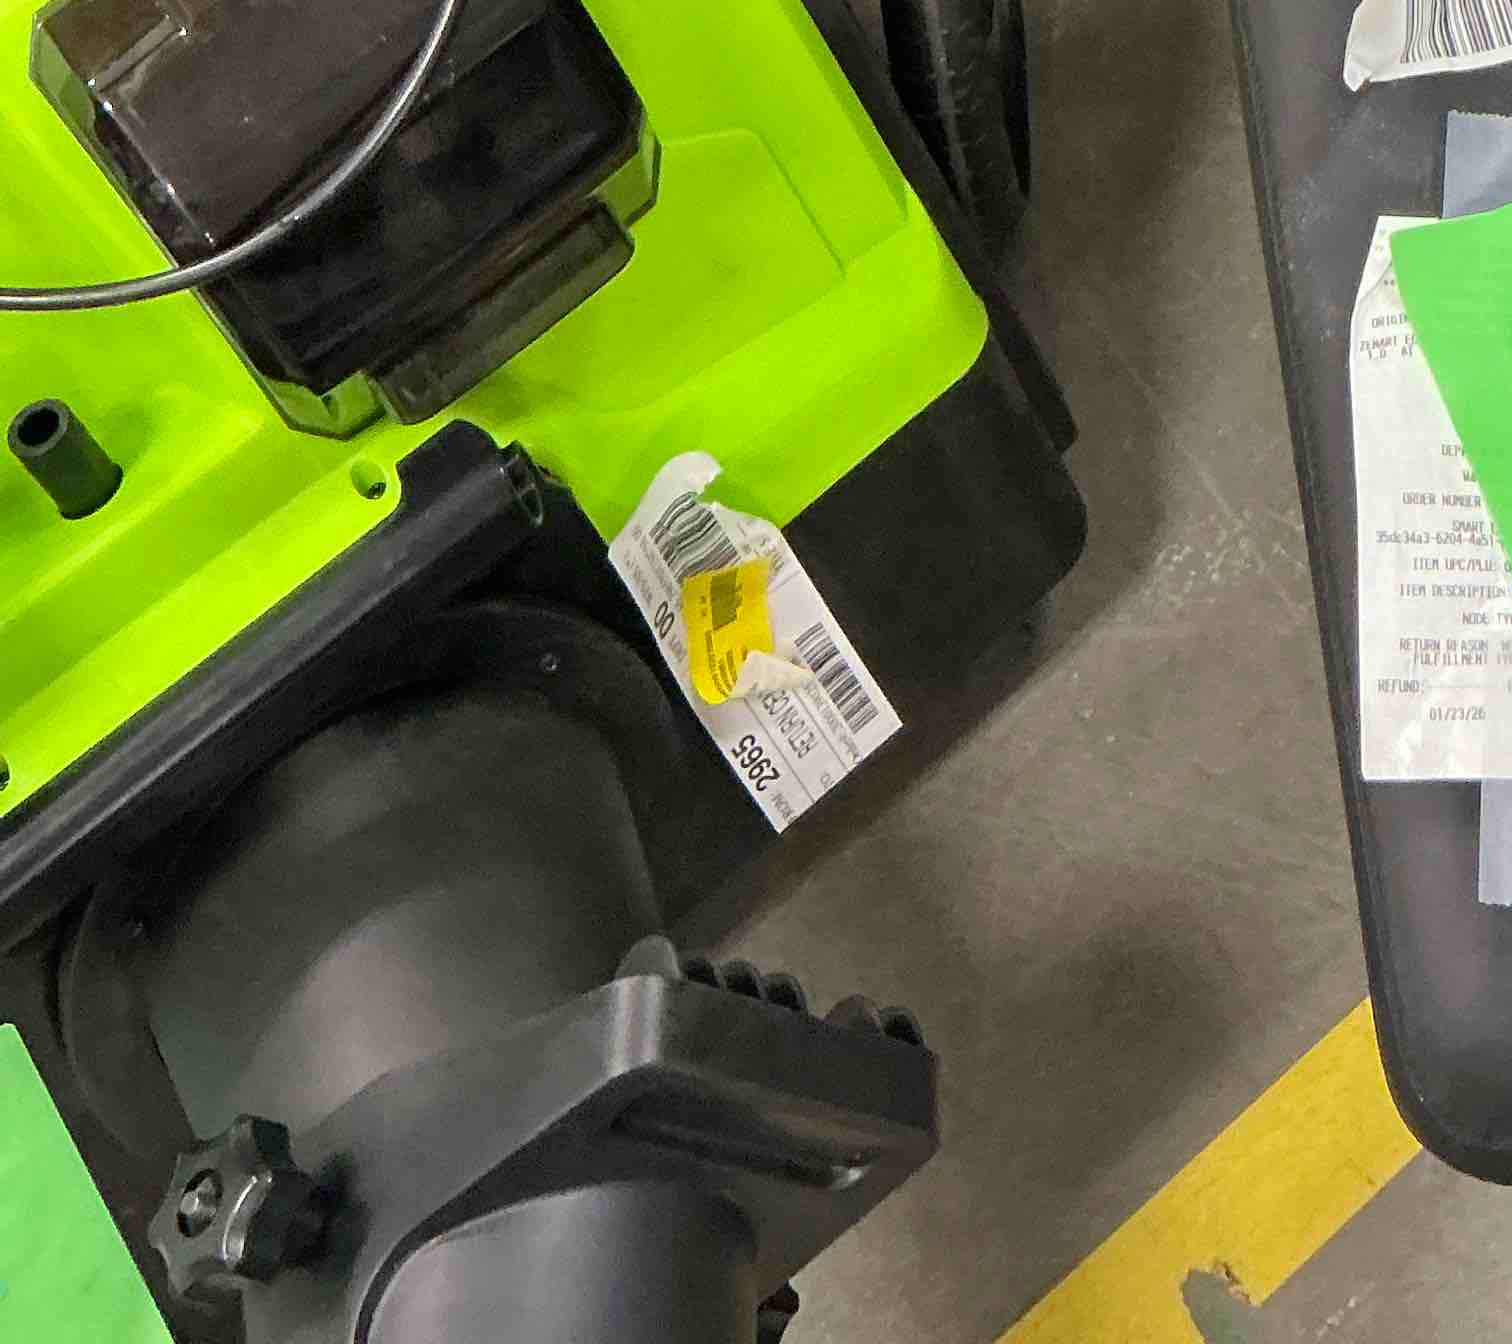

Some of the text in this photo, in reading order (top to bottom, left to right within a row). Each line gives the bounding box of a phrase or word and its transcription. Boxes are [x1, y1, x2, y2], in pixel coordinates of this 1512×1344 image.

[653, 601, 677, 641] 00
[774, 702, 819, 759] RETURN
[731, 733, 781, 791] 2965
